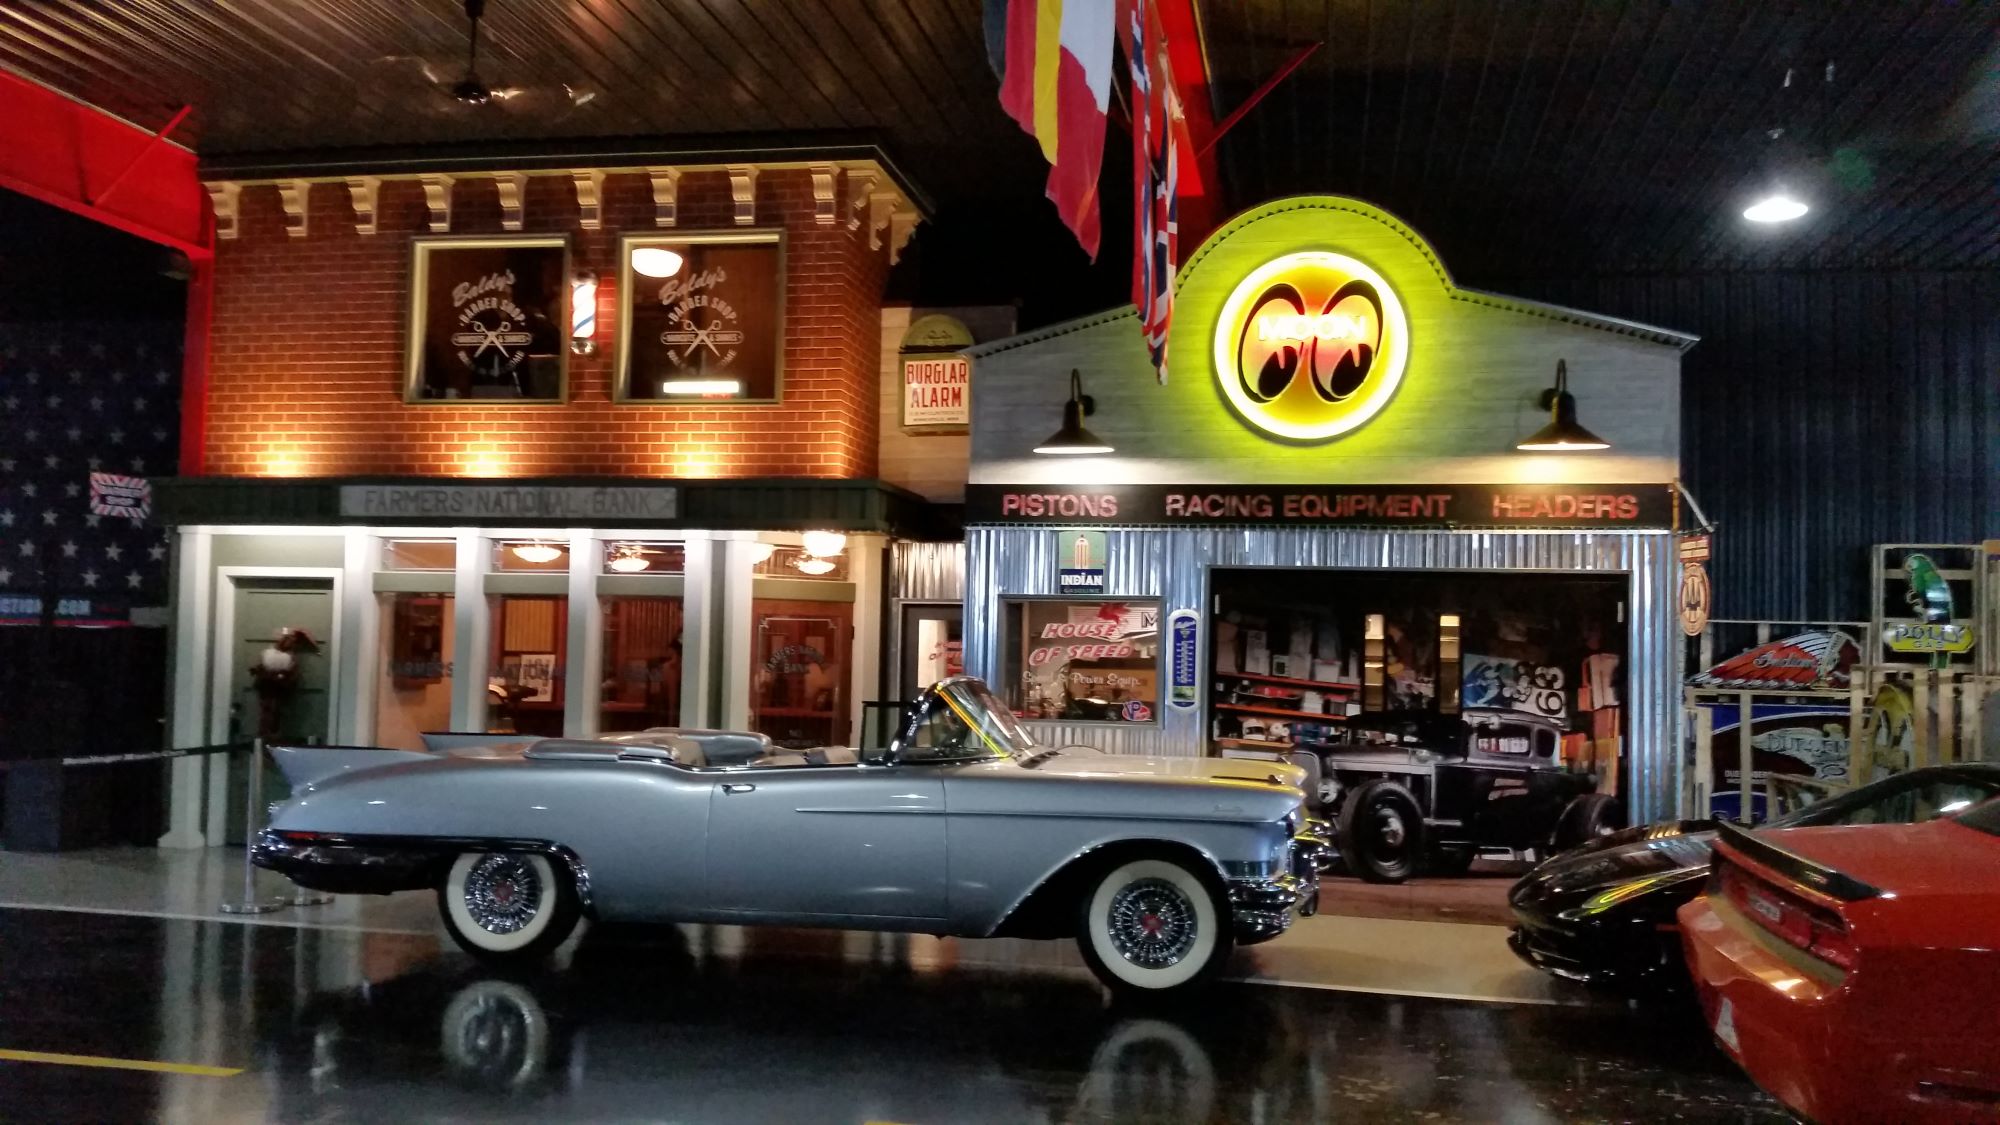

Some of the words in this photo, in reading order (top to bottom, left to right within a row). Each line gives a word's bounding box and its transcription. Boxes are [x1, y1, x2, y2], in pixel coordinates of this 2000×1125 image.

[1257, 314, 1367, 341] MOON
[906, 362, 968, 385] BURGLAR
[911, 386, 962, 408] ALARM
[364, 490, 462, 513] FARMERS
[476, 489, 583, 514] NATIONAL
[592, 490, 652, 514] BANK
[1002, 494, 1118, 517] PISTONS
[1165, 494, 1273, 517] RACING
[1282, 494, 1451, 518] EQUIPMENT
[1491, 494, 1639, 519] HEADERS
[1061, 572, 1103, 586] INDIAN
[1041, 623, 1117, 638] HOUSE
[1894, 624, 1965, 644] POLLY
[1029, 647, 1062, 666] OF
[1067, 644, 1134, 661] SPEED
[1912, 641, 1944, 649] GAS
